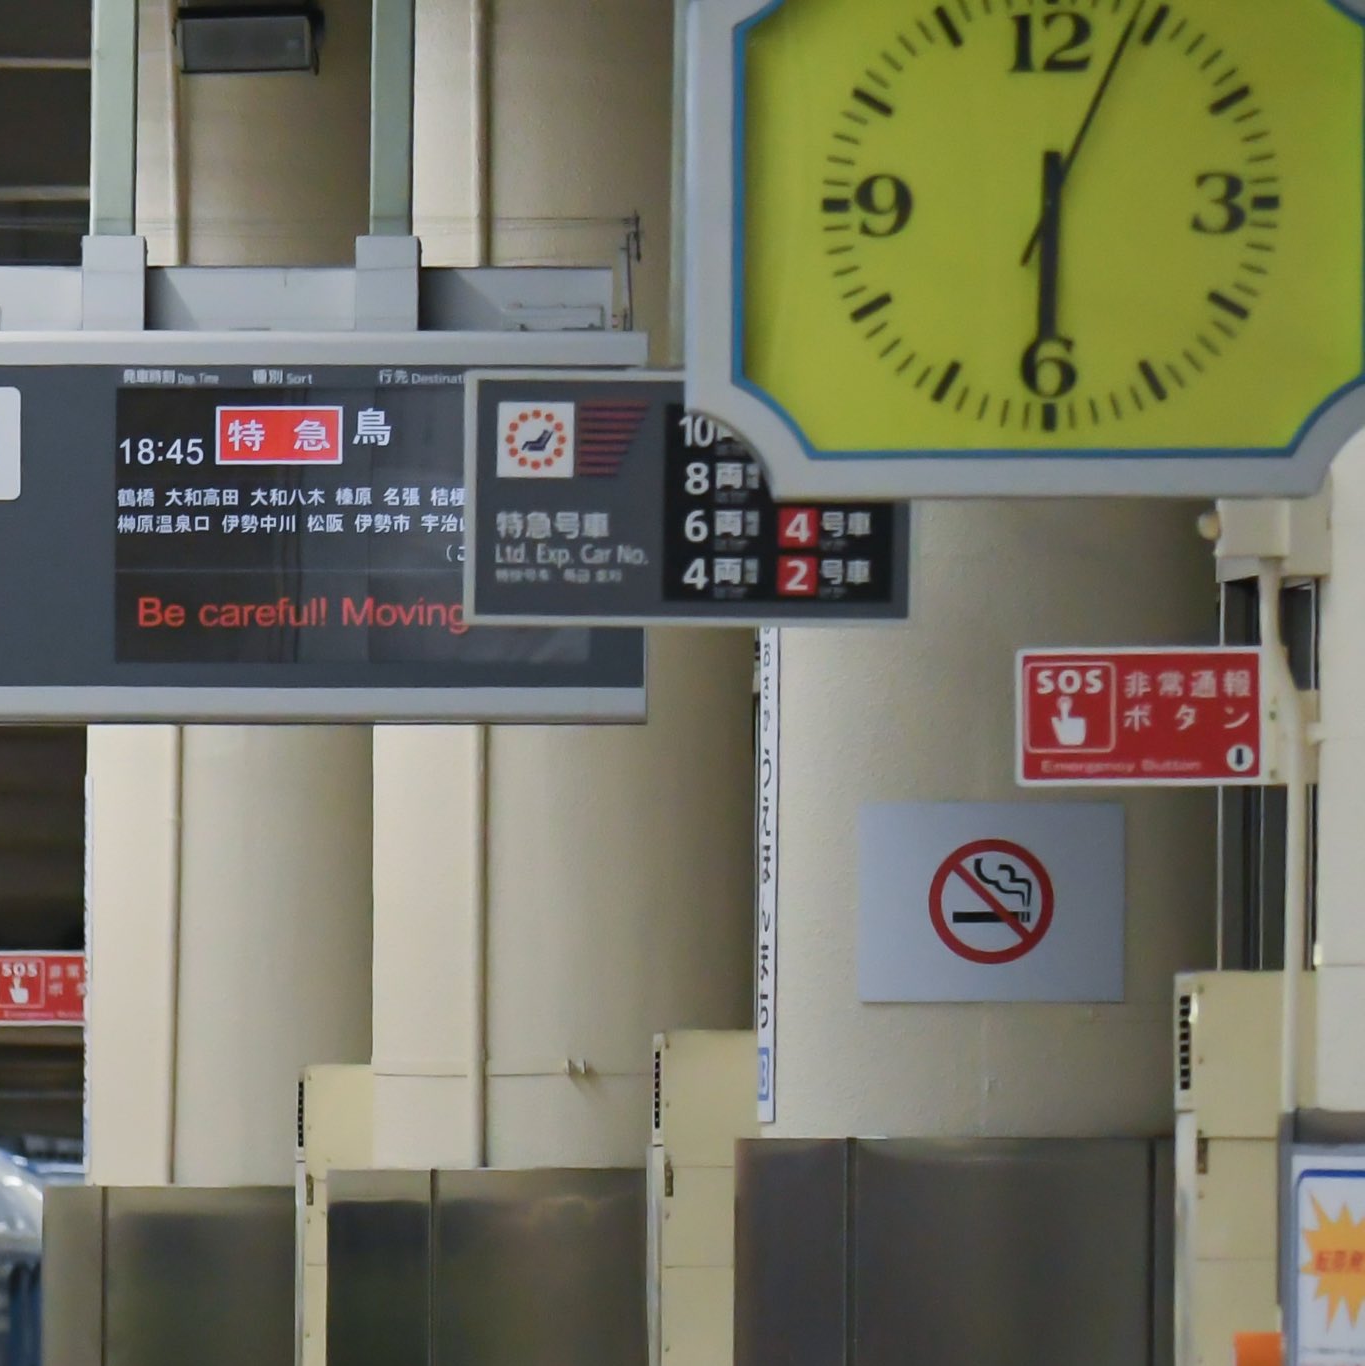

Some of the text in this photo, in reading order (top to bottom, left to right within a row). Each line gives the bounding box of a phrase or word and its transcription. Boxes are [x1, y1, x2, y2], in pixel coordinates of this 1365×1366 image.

[1009, 12, 1092, 72] 12
[854, 175, 913, 238] 9
[1190, 173, 1246, 235] 3
[286, 373, 313, 385] Sort
[1020, 337, 1077, 399] 6
[119, 408, 392, 465] 18:45 特急 鳥
[118, 488, 155, 508] 鶴橋
[165, 488, 239, 507] 大和高田
[250, 488, 325, 507] 大和八木
[335, 488, 373, 507] 榛原
[383, 488, 420, 507] 名張
[117, 515, 210, 534] 榊原温泉口
[222, 515, 296, 534] 伊勢中川
[307, 515, 344, 533] 松阪
[355, 514, 411, 534] 伊勢市
[496, 511, 610, 539] 特急号車
[785, 513, 812, 543] 4
[495, 543, 648, 569] Ltd. Exp. Car No.
[785, 560, 809, 591] 2
[137, 597, 469, 634] Be careful! Moving
[1036, 669, 1104, 694] SOS
[1123, 670, 1252, 698] 非常通報
[1123, 704, 1251, 731] ボタン
[2, 962, 38, 977] SOS
